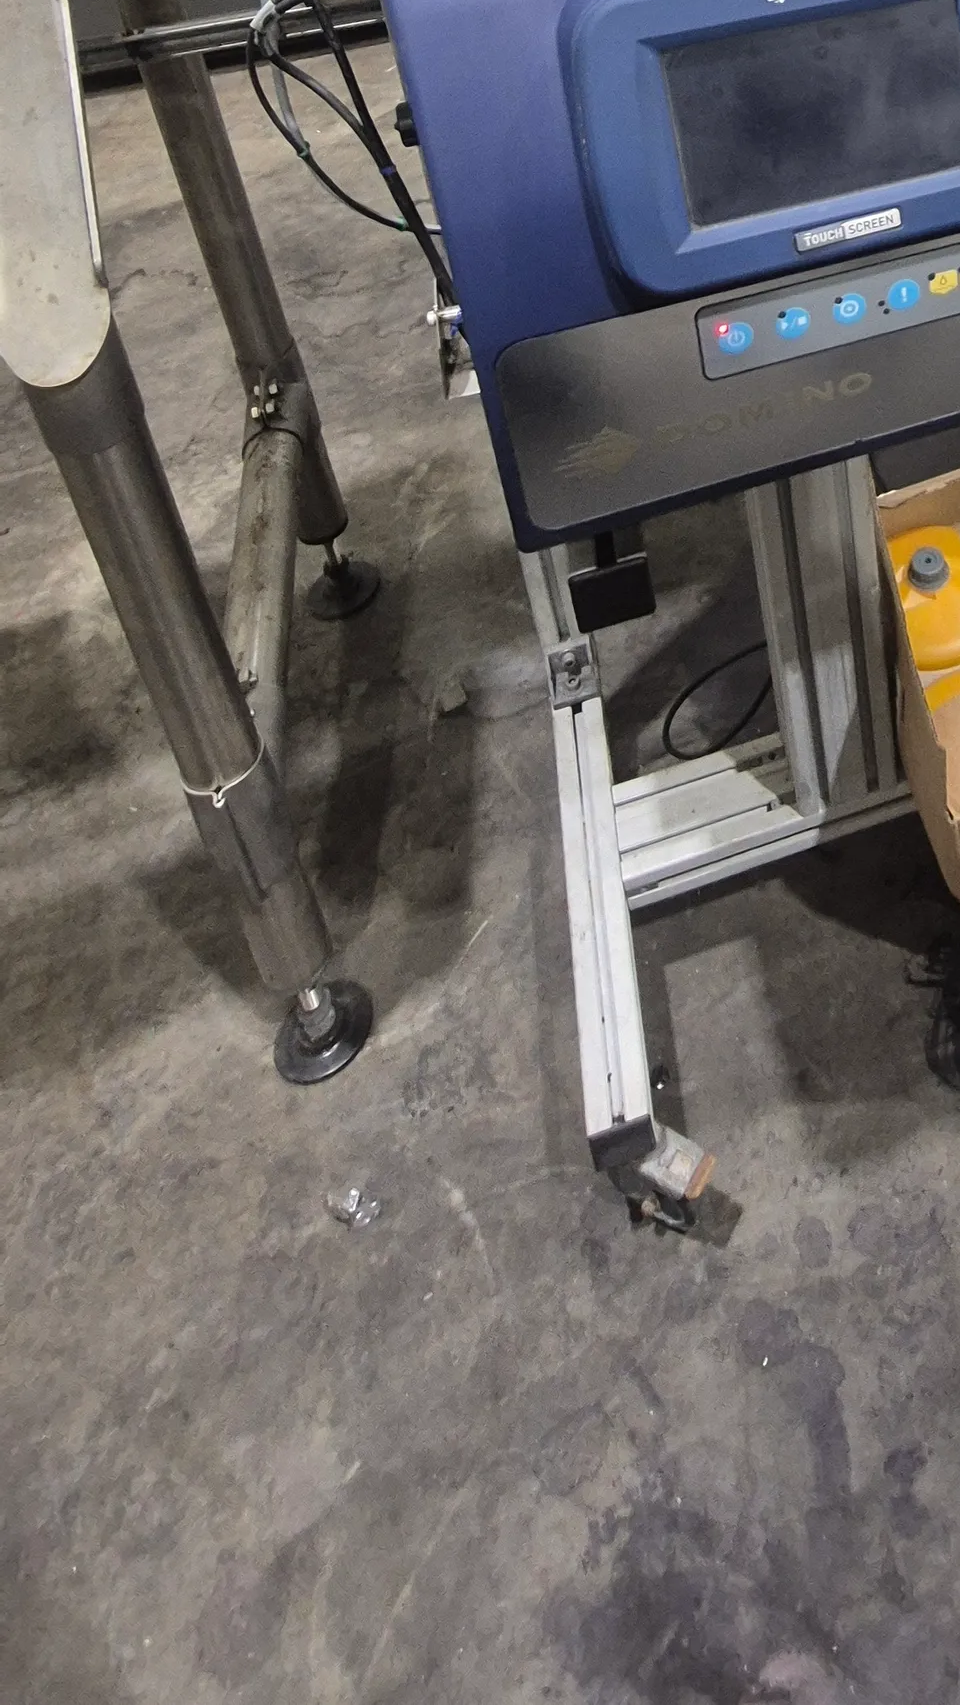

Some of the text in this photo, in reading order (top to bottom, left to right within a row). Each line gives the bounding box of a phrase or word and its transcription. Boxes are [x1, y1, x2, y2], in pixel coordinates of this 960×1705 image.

[803, 214, 894, 247] TOUCH SCREEN
[656, 371, 873, 444] DOMNO
